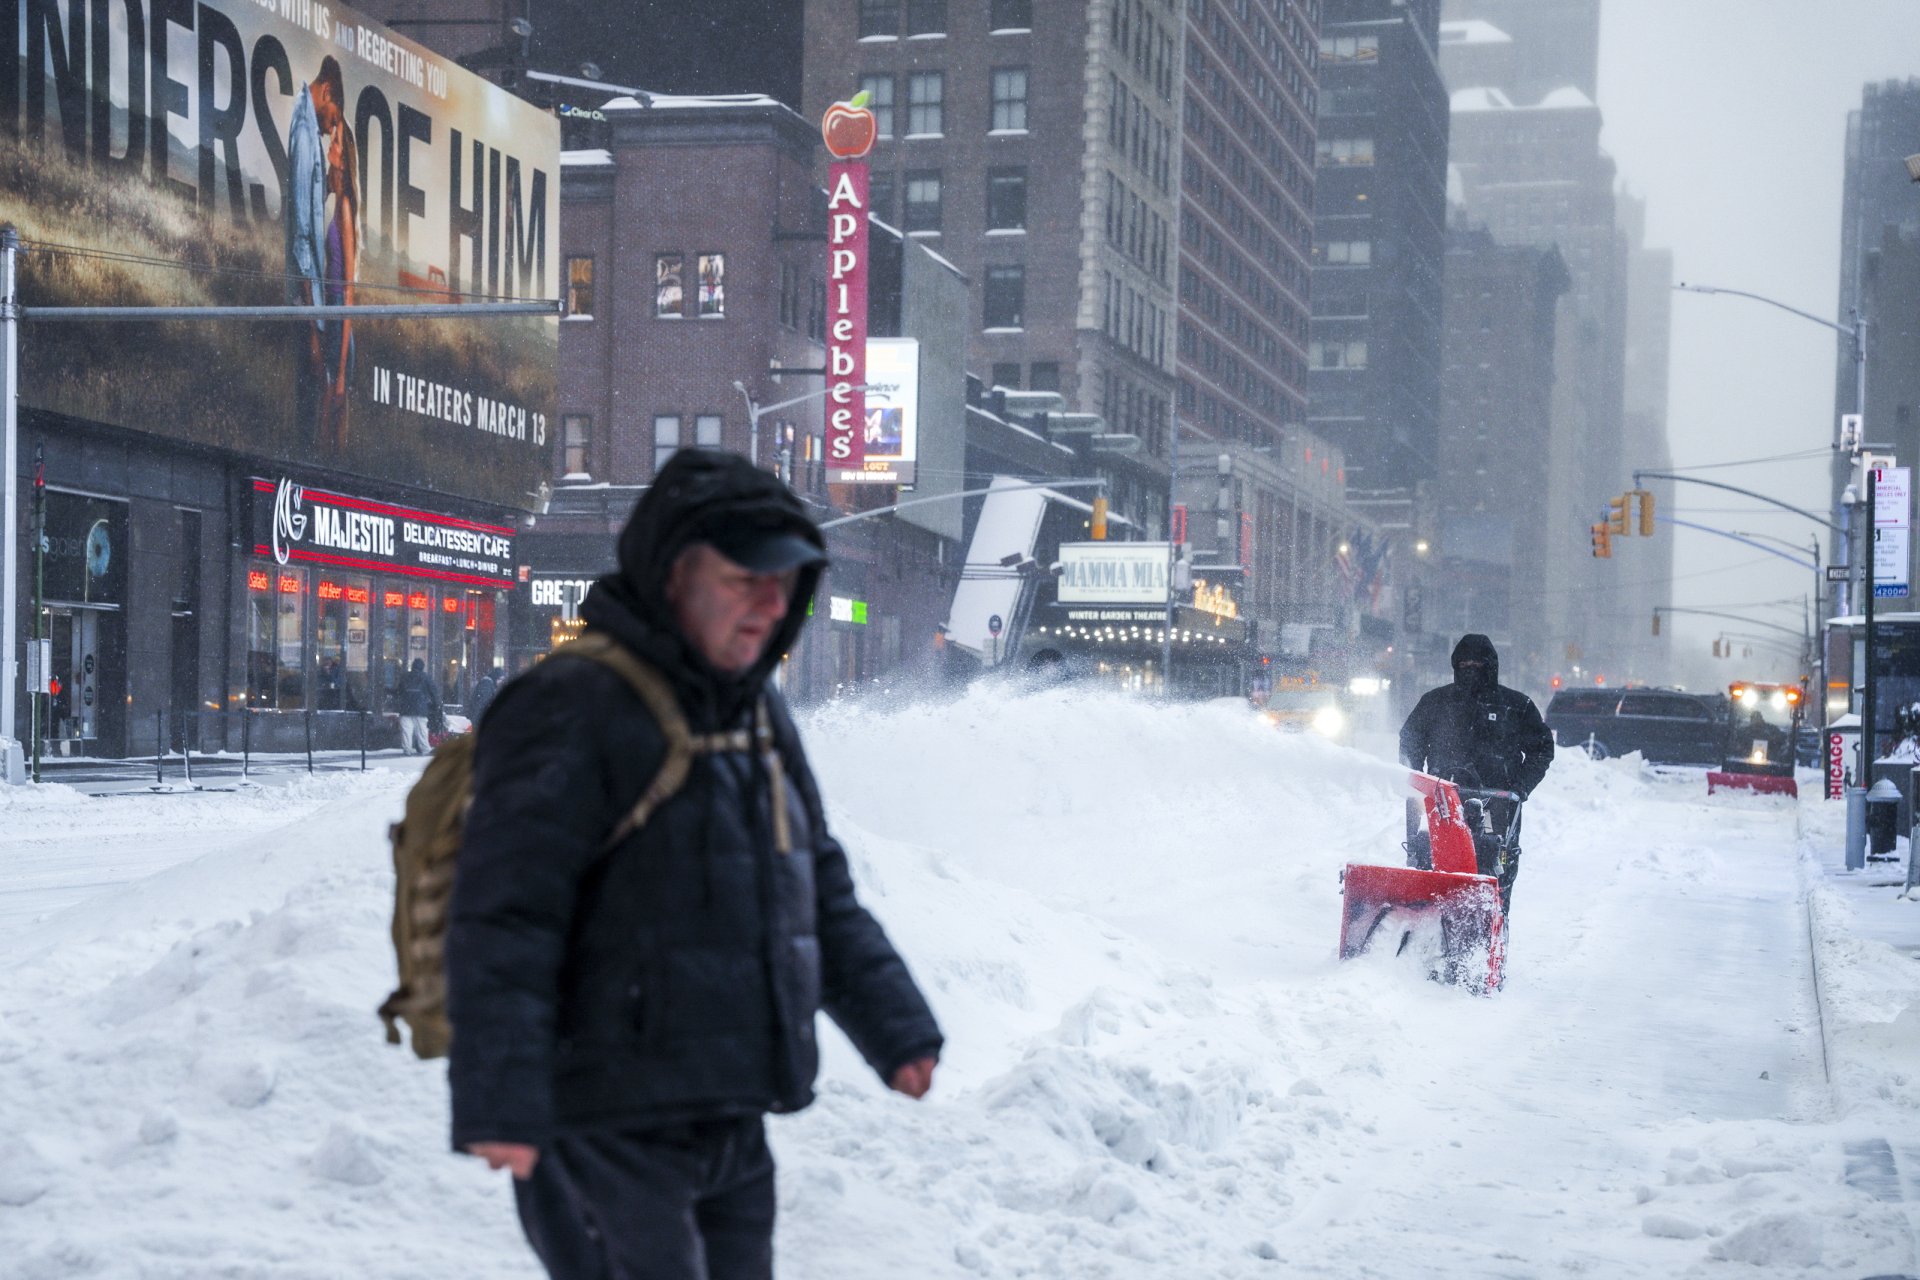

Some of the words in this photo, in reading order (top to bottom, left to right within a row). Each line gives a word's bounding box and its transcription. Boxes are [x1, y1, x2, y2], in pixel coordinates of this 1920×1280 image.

[279, 0, 310, 30] WITH
[313, 2, 330, 40] US
[334, 20, 354, 52] AND
[357, 25, 424, 89] REGRETTING
[426, 62, 447, 100] YOU
[354, 84, 432, 270] OF
[450, 127, 547, 301] HIM
[828, 172, 863, 459] Applebee's
[373, 366, 391, 405] IN
[396, 372, 472, 427] THEATERS
[477, 396, 526, 441] MARCH
[532, 412, 546, 446] 13
[314, 505, 395, 556] MAJESTIC
[403, 521, 481, 555] DELICATESSEN
[483, 534, 511, 559] CAFE
[1060, 562, 1128, 587] MAMMA
[1068, 611, 1099, 621] WINTER
[1100, 611, 1132, 621] GARDEN
[1133, 611, 1168, 621] THEATRE
